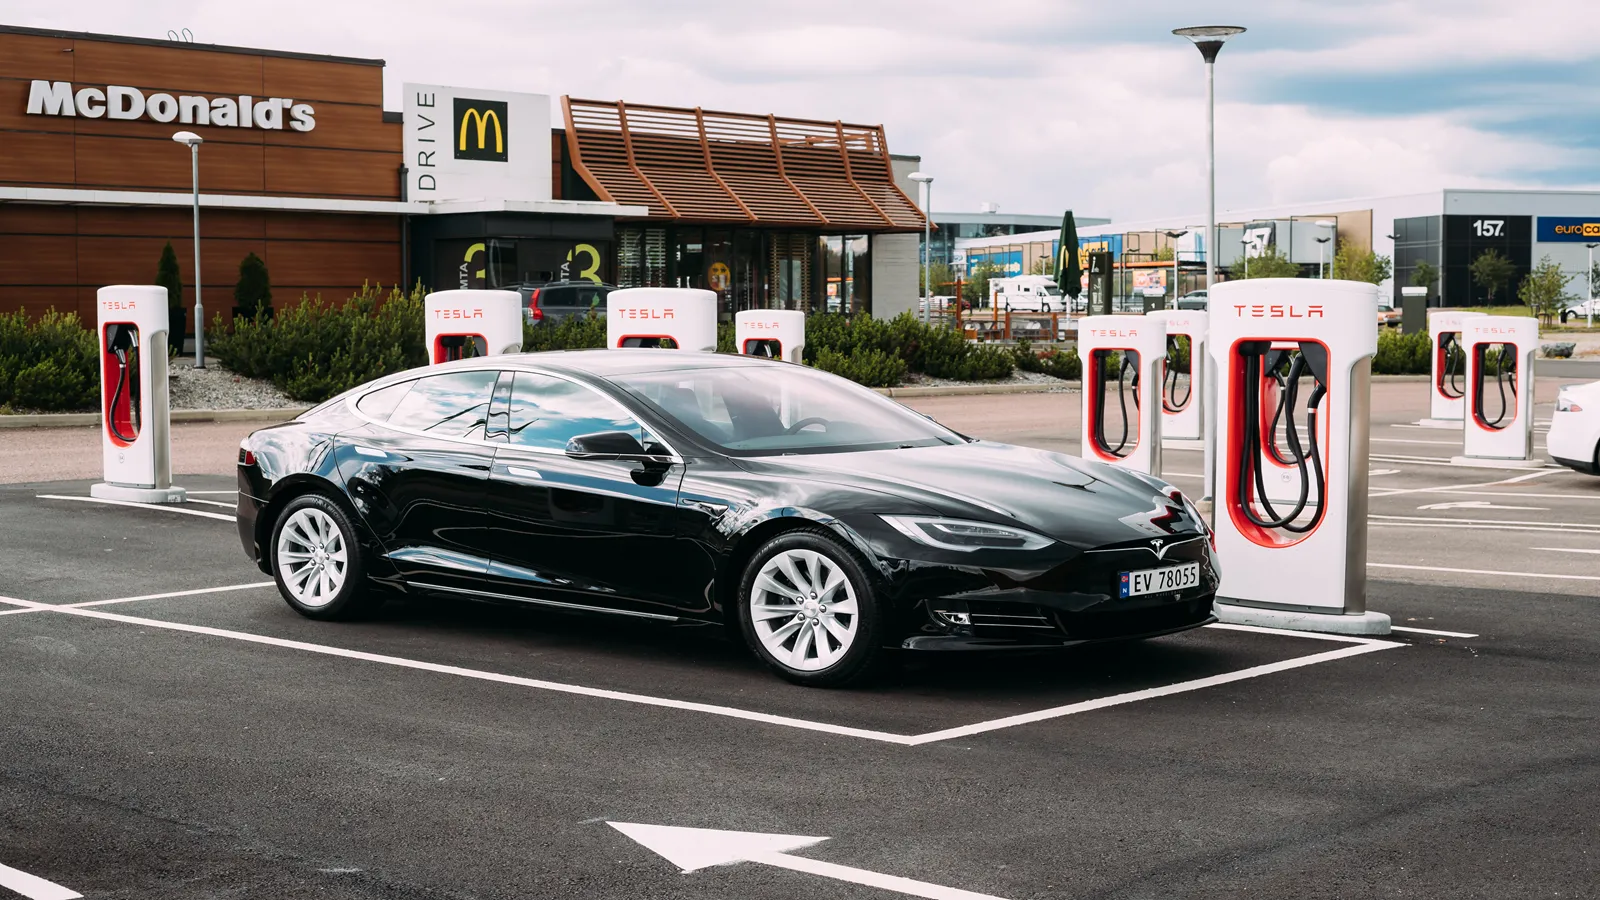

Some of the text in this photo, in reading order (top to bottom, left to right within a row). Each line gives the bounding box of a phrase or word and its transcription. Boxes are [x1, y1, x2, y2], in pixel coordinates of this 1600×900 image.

[26, 79, 316, 132] McDonald's
[417, 91, 437, 191] DRIVE
[102, 301, 136, 310] TESLA
[1234, 304, 1324, 318] TESLA
[434, 309, 483, 320] TESLA
[619, 308, 674, 319] TESLA
[743, 321, 780, 329] TESLA
[1090, 329, 1138, 337] TESLA
[1134, 566, 1196, 593] EV 78055
